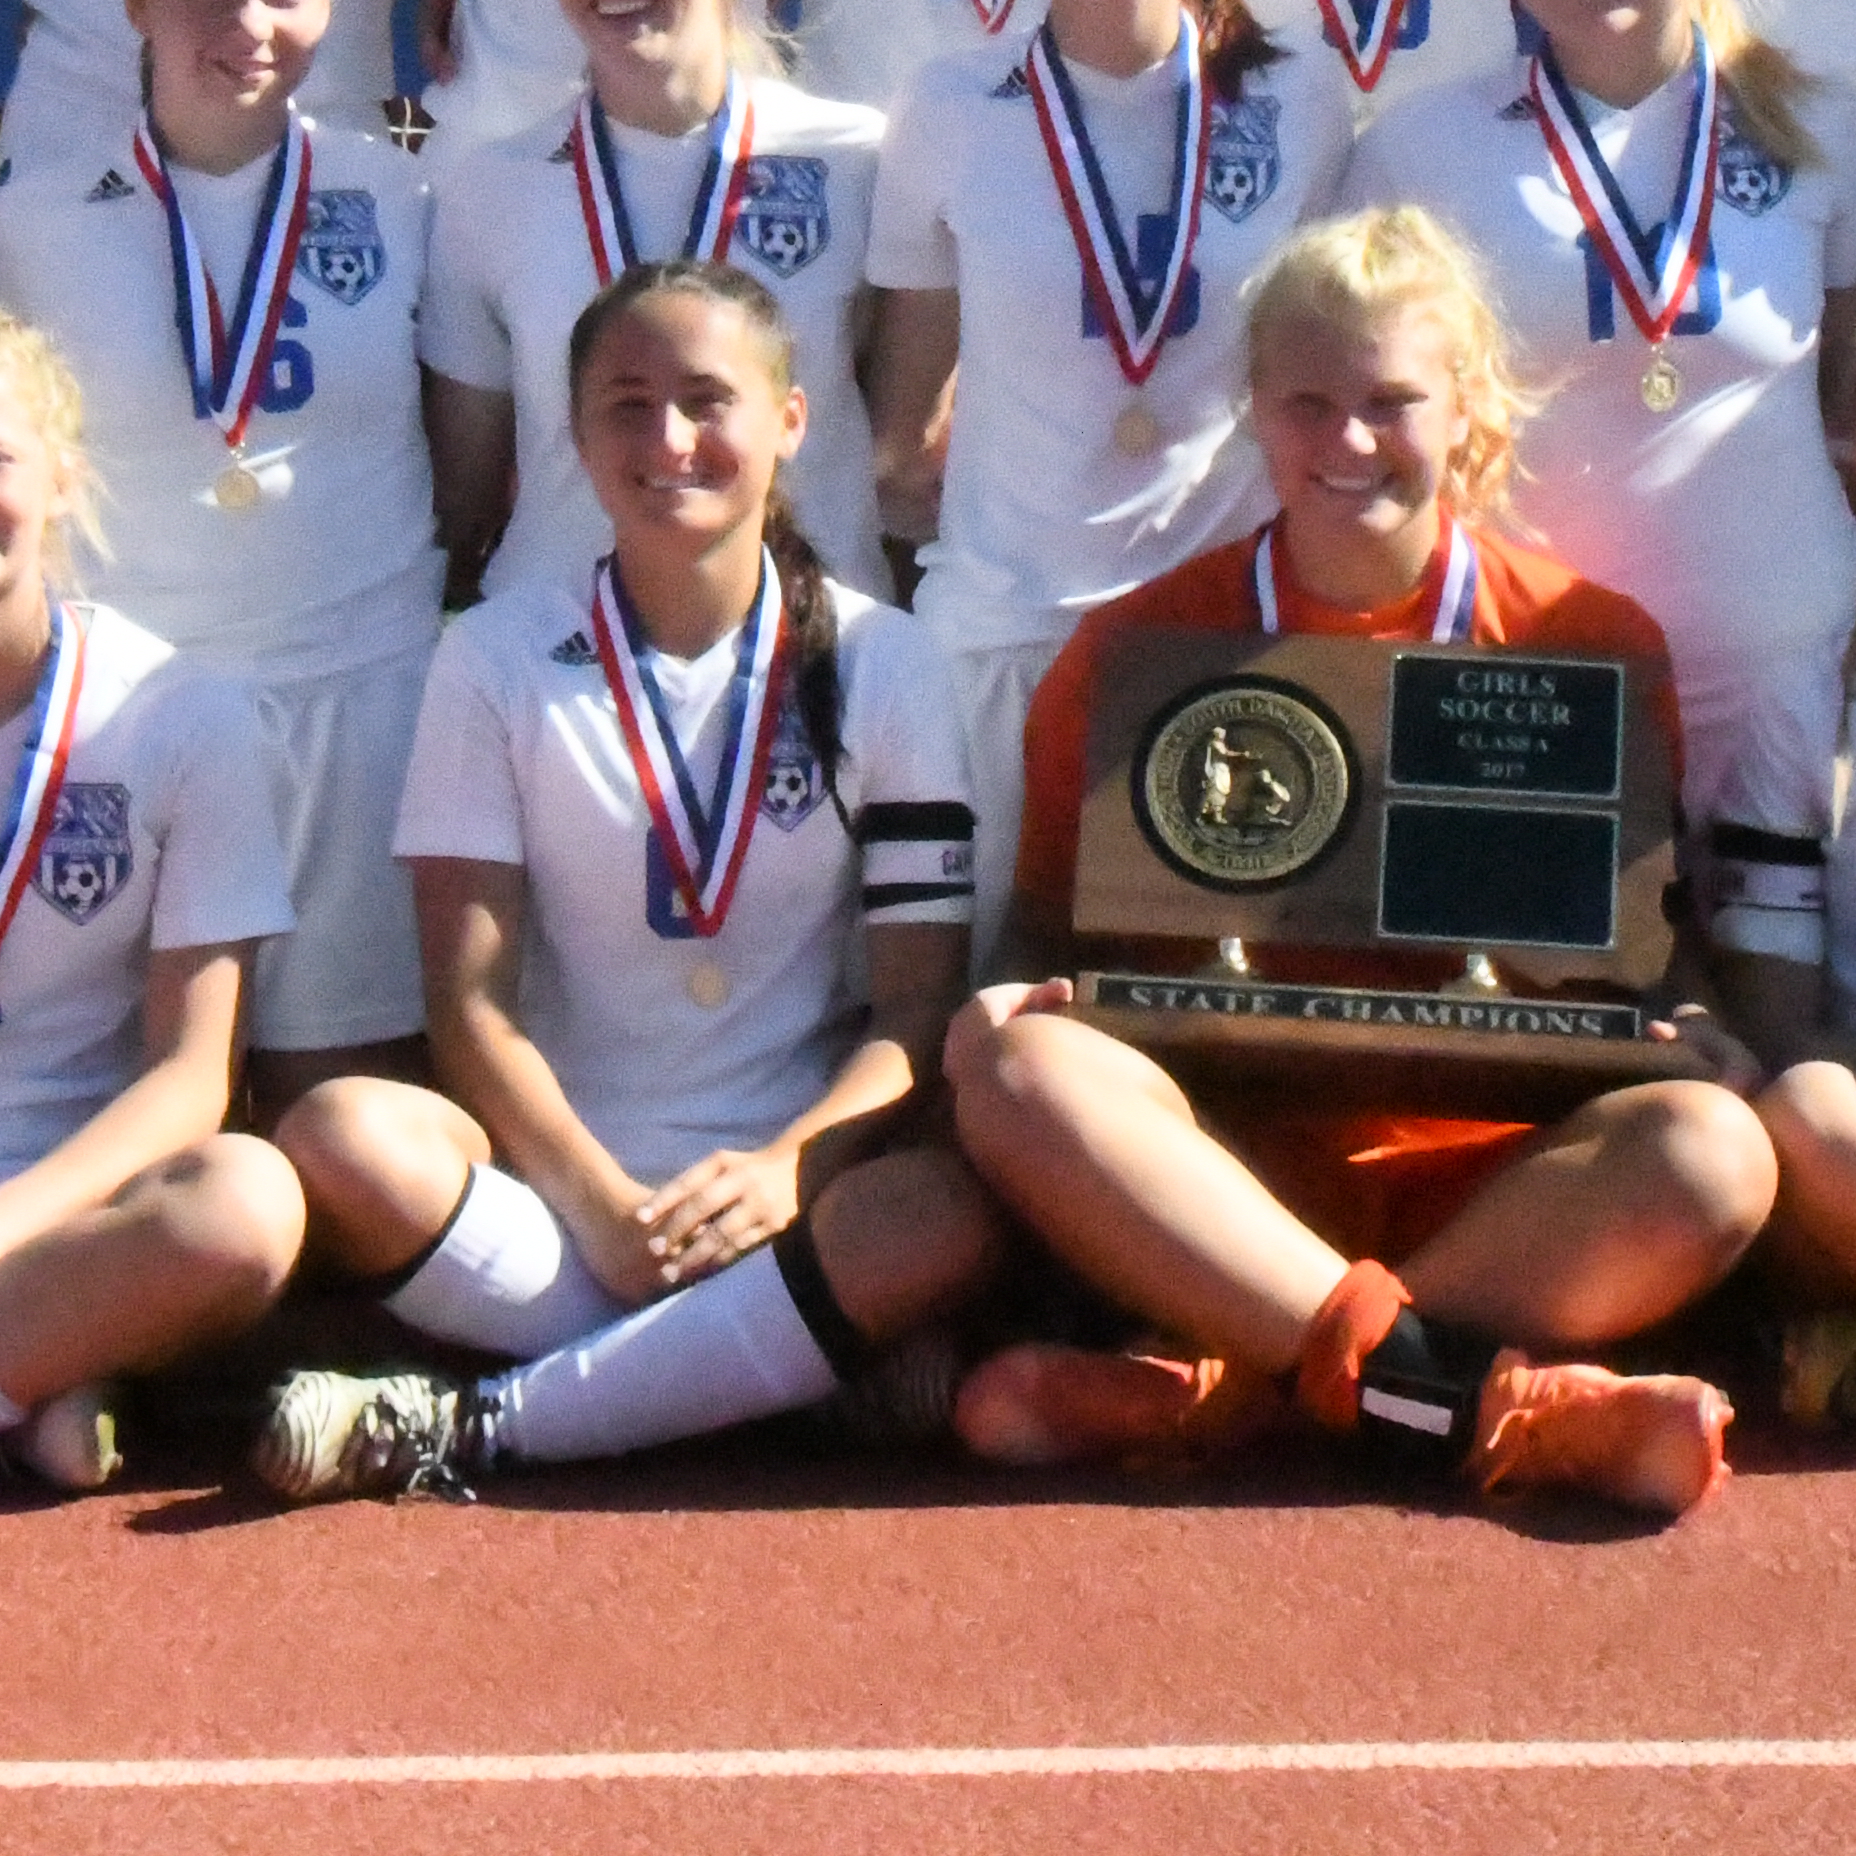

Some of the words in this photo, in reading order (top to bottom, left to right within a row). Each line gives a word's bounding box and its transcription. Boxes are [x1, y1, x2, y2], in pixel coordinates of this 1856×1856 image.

[1457, 671, 1556, 695] GIRLS
[1440, 698, 1571, 726] SOCCER
[1457, 733, 1531, 752] CLASS
[1130, 987, 1277, 1016] STATE
[1302, 996, 1606, 1036] CHAMPIONS
